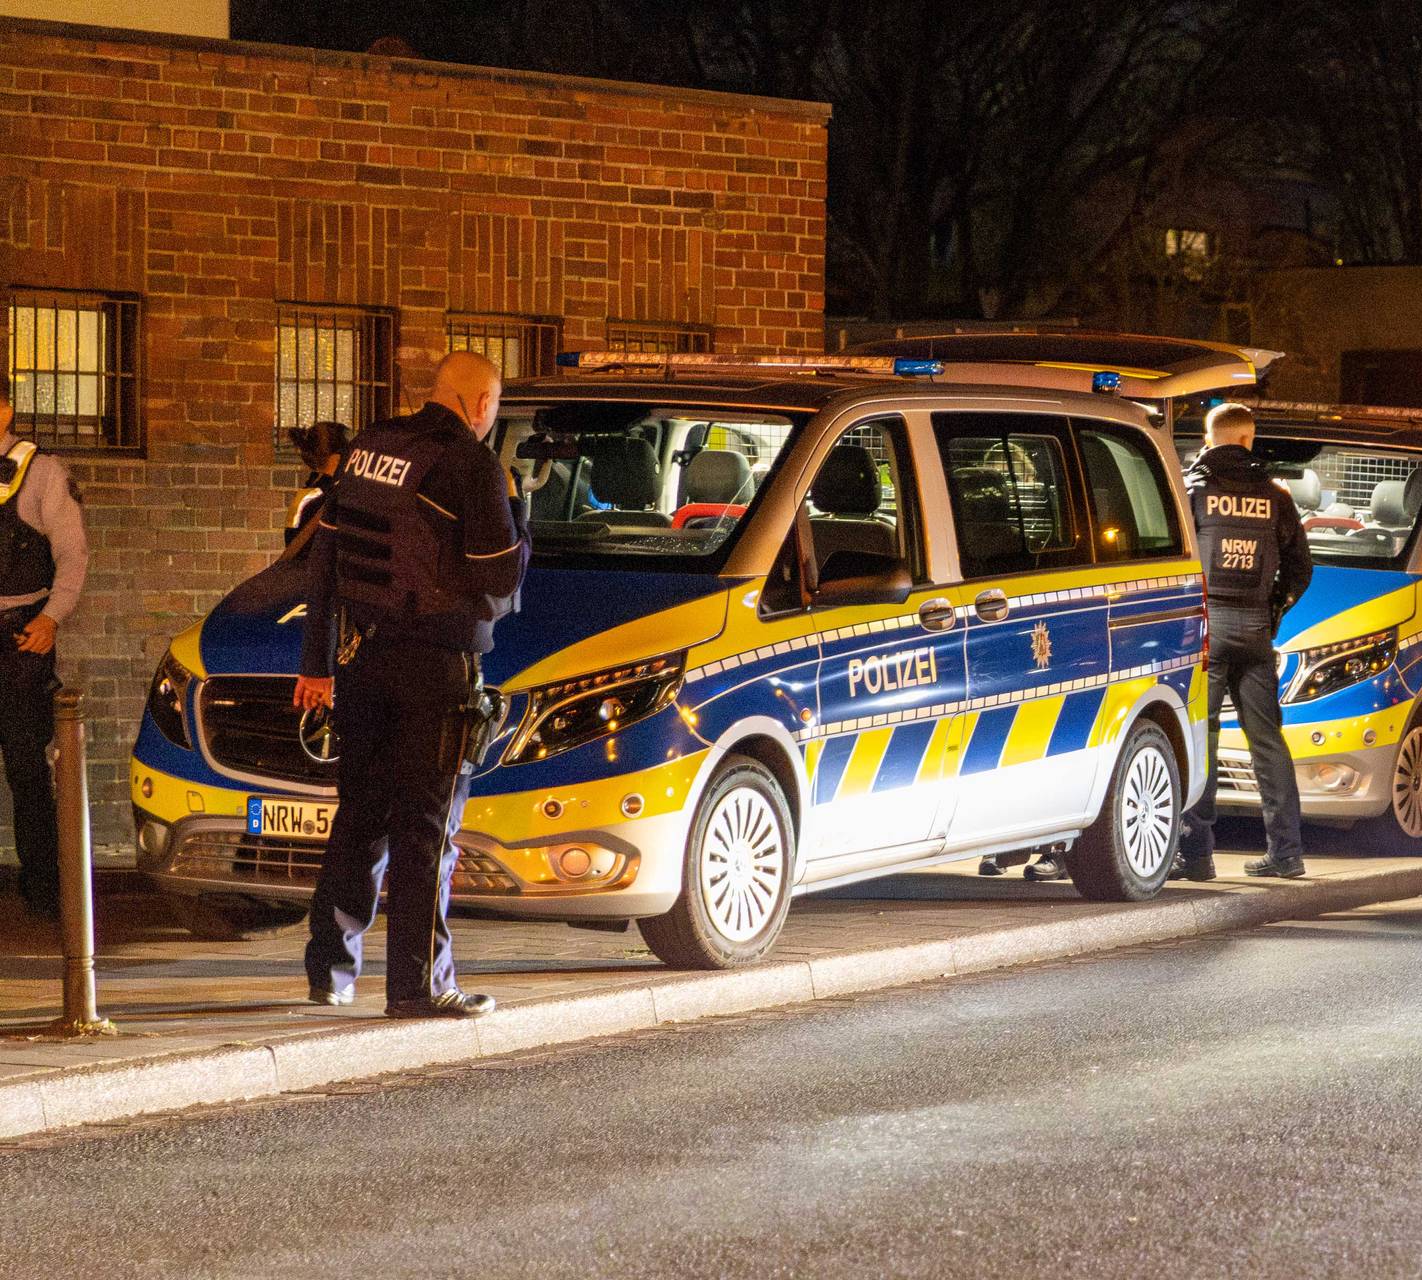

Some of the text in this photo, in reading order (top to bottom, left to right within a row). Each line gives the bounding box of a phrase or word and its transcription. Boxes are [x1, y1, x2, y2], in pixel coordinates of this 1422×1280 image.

[344, 448, 412, 487] POLIZEI
[1206, 495, 1271, 519] POLIZEI
[1221, 538, 1257, 554] NRW
[1222, 553, 1254, 569] 2713
[848, 646, 937, 697] POLIZEI
[263, 804, 332, 834] NRW 5
